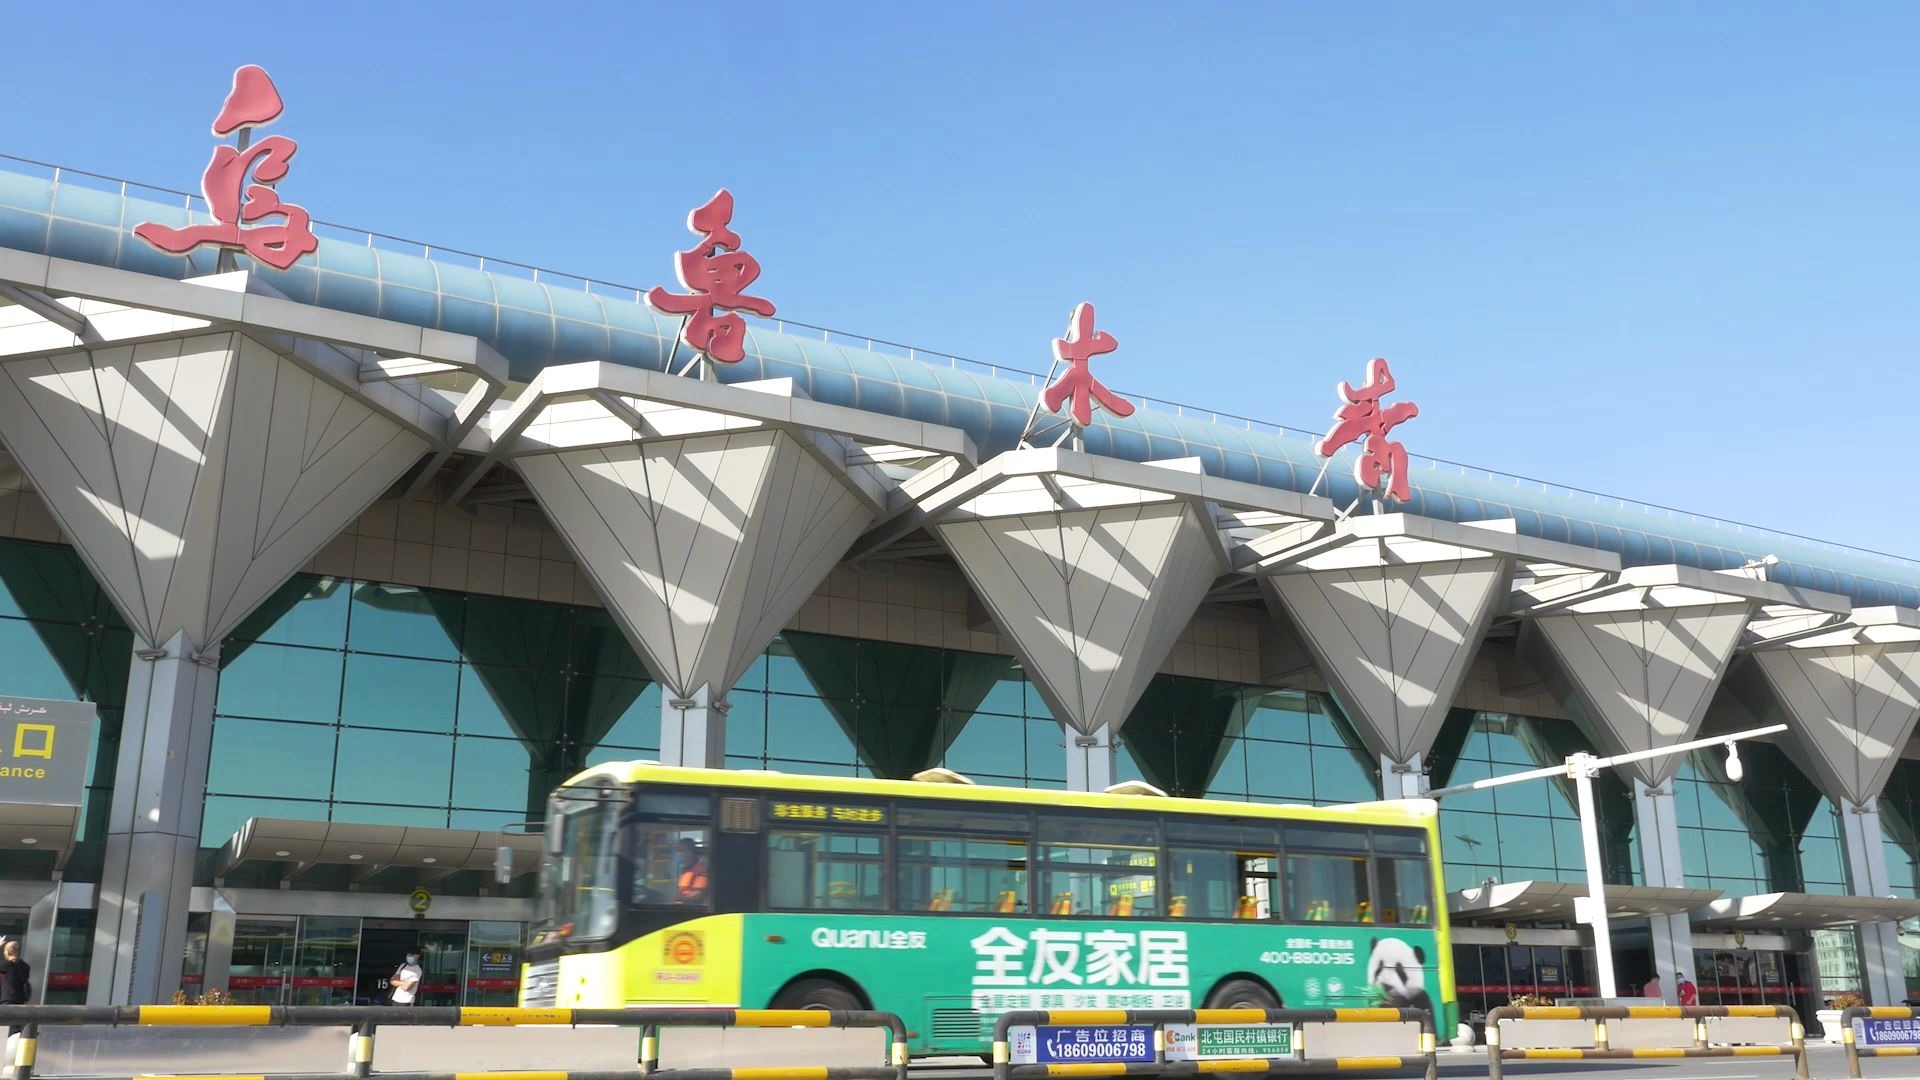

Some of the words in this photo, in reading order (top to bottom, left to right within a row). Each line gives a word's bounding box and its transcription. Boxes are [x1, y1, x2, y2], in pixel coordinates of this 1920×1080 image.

[414, 893, 427, 910] 2
[970, 927, 1190, 987] 全友家居
[1056, 1029, 1146, 1043] 广告位招商
[1201, 1029, 1288, 1044] 北屯国民村镇银行
[1056, 1043, 1146, 1058] 18609006798
